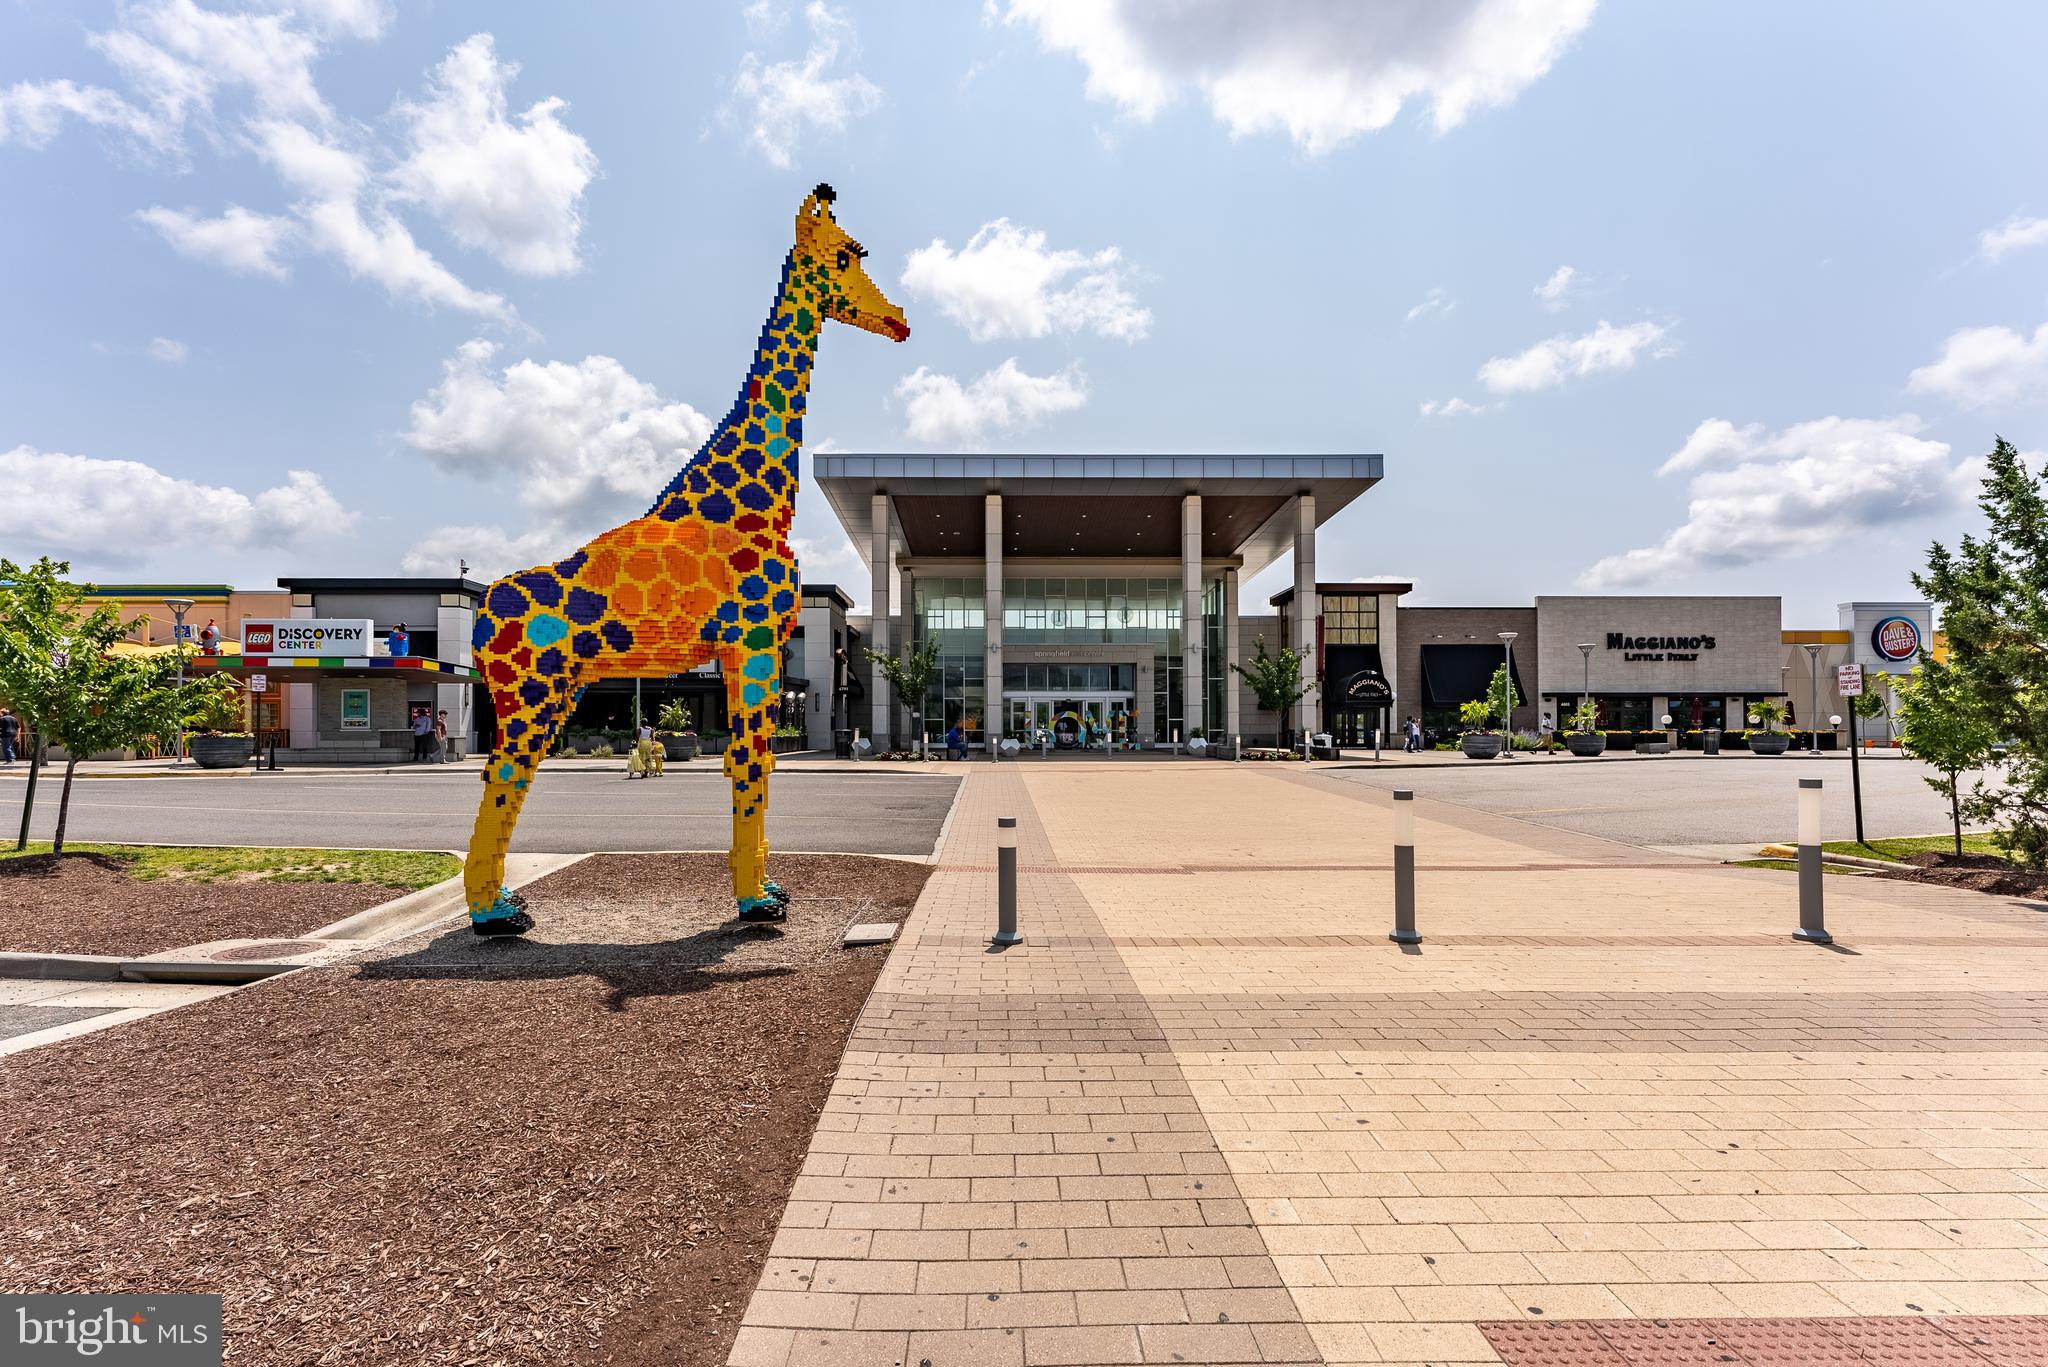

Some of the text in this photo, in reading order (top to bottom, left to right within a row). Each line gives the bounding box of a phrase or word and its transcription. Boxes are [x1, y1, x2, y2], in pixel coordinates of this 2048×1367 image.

[248, 632, 271, 643] LEGO
[1884, 627, 1913, 641] DAVE &
[279, 641, 322, 649] CENTER
[1607, 632, 1716, 650] MAGGIANO'S
[1884, 638, 1915, 651] BUSTER'S
[1624, 652, 1699, 661] LITTLE ITALY
[1348, 679, 1389, 695] MAGGIANO'S
